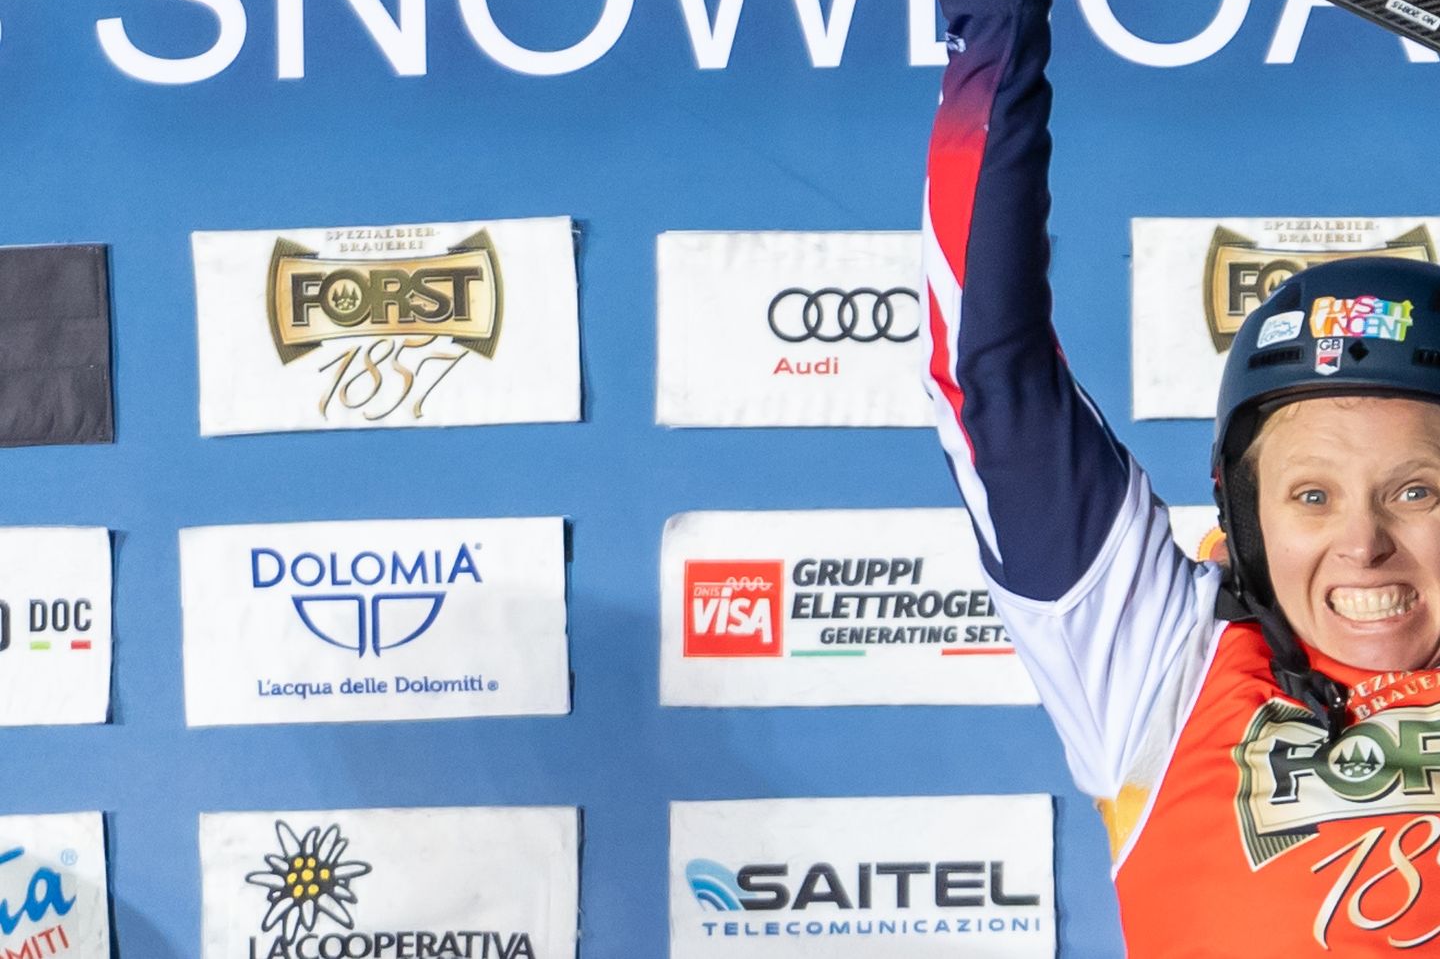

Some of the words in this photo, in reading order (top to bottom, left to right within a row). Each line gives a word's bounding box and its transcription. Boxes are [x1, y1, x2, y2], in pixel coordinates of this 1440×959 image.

[339, 240, 425, 252] BRAUEREI
[291, 266, 484, 328] FORST
[1319, 340, 1341, 351] GB
[318, 335, 470, 421] 1857
[773, 357, 840, 374] Audi
[251, 542, 483, 589] DOLOMIA
[792, 557, 924, 587] GRUPPI
[29, 598, 92, 633] DOC
[820, 625, 958, 645] GENERATING
[257, 679, 334, 700] L'acqua
[339, 677, 388, 694] delle
[395, 674, 484, 693] Dolomiti
[736, 860, 1042, 912] SAITEL
[701, 917, 1042, 937] TELECOMUNICAZIONI
